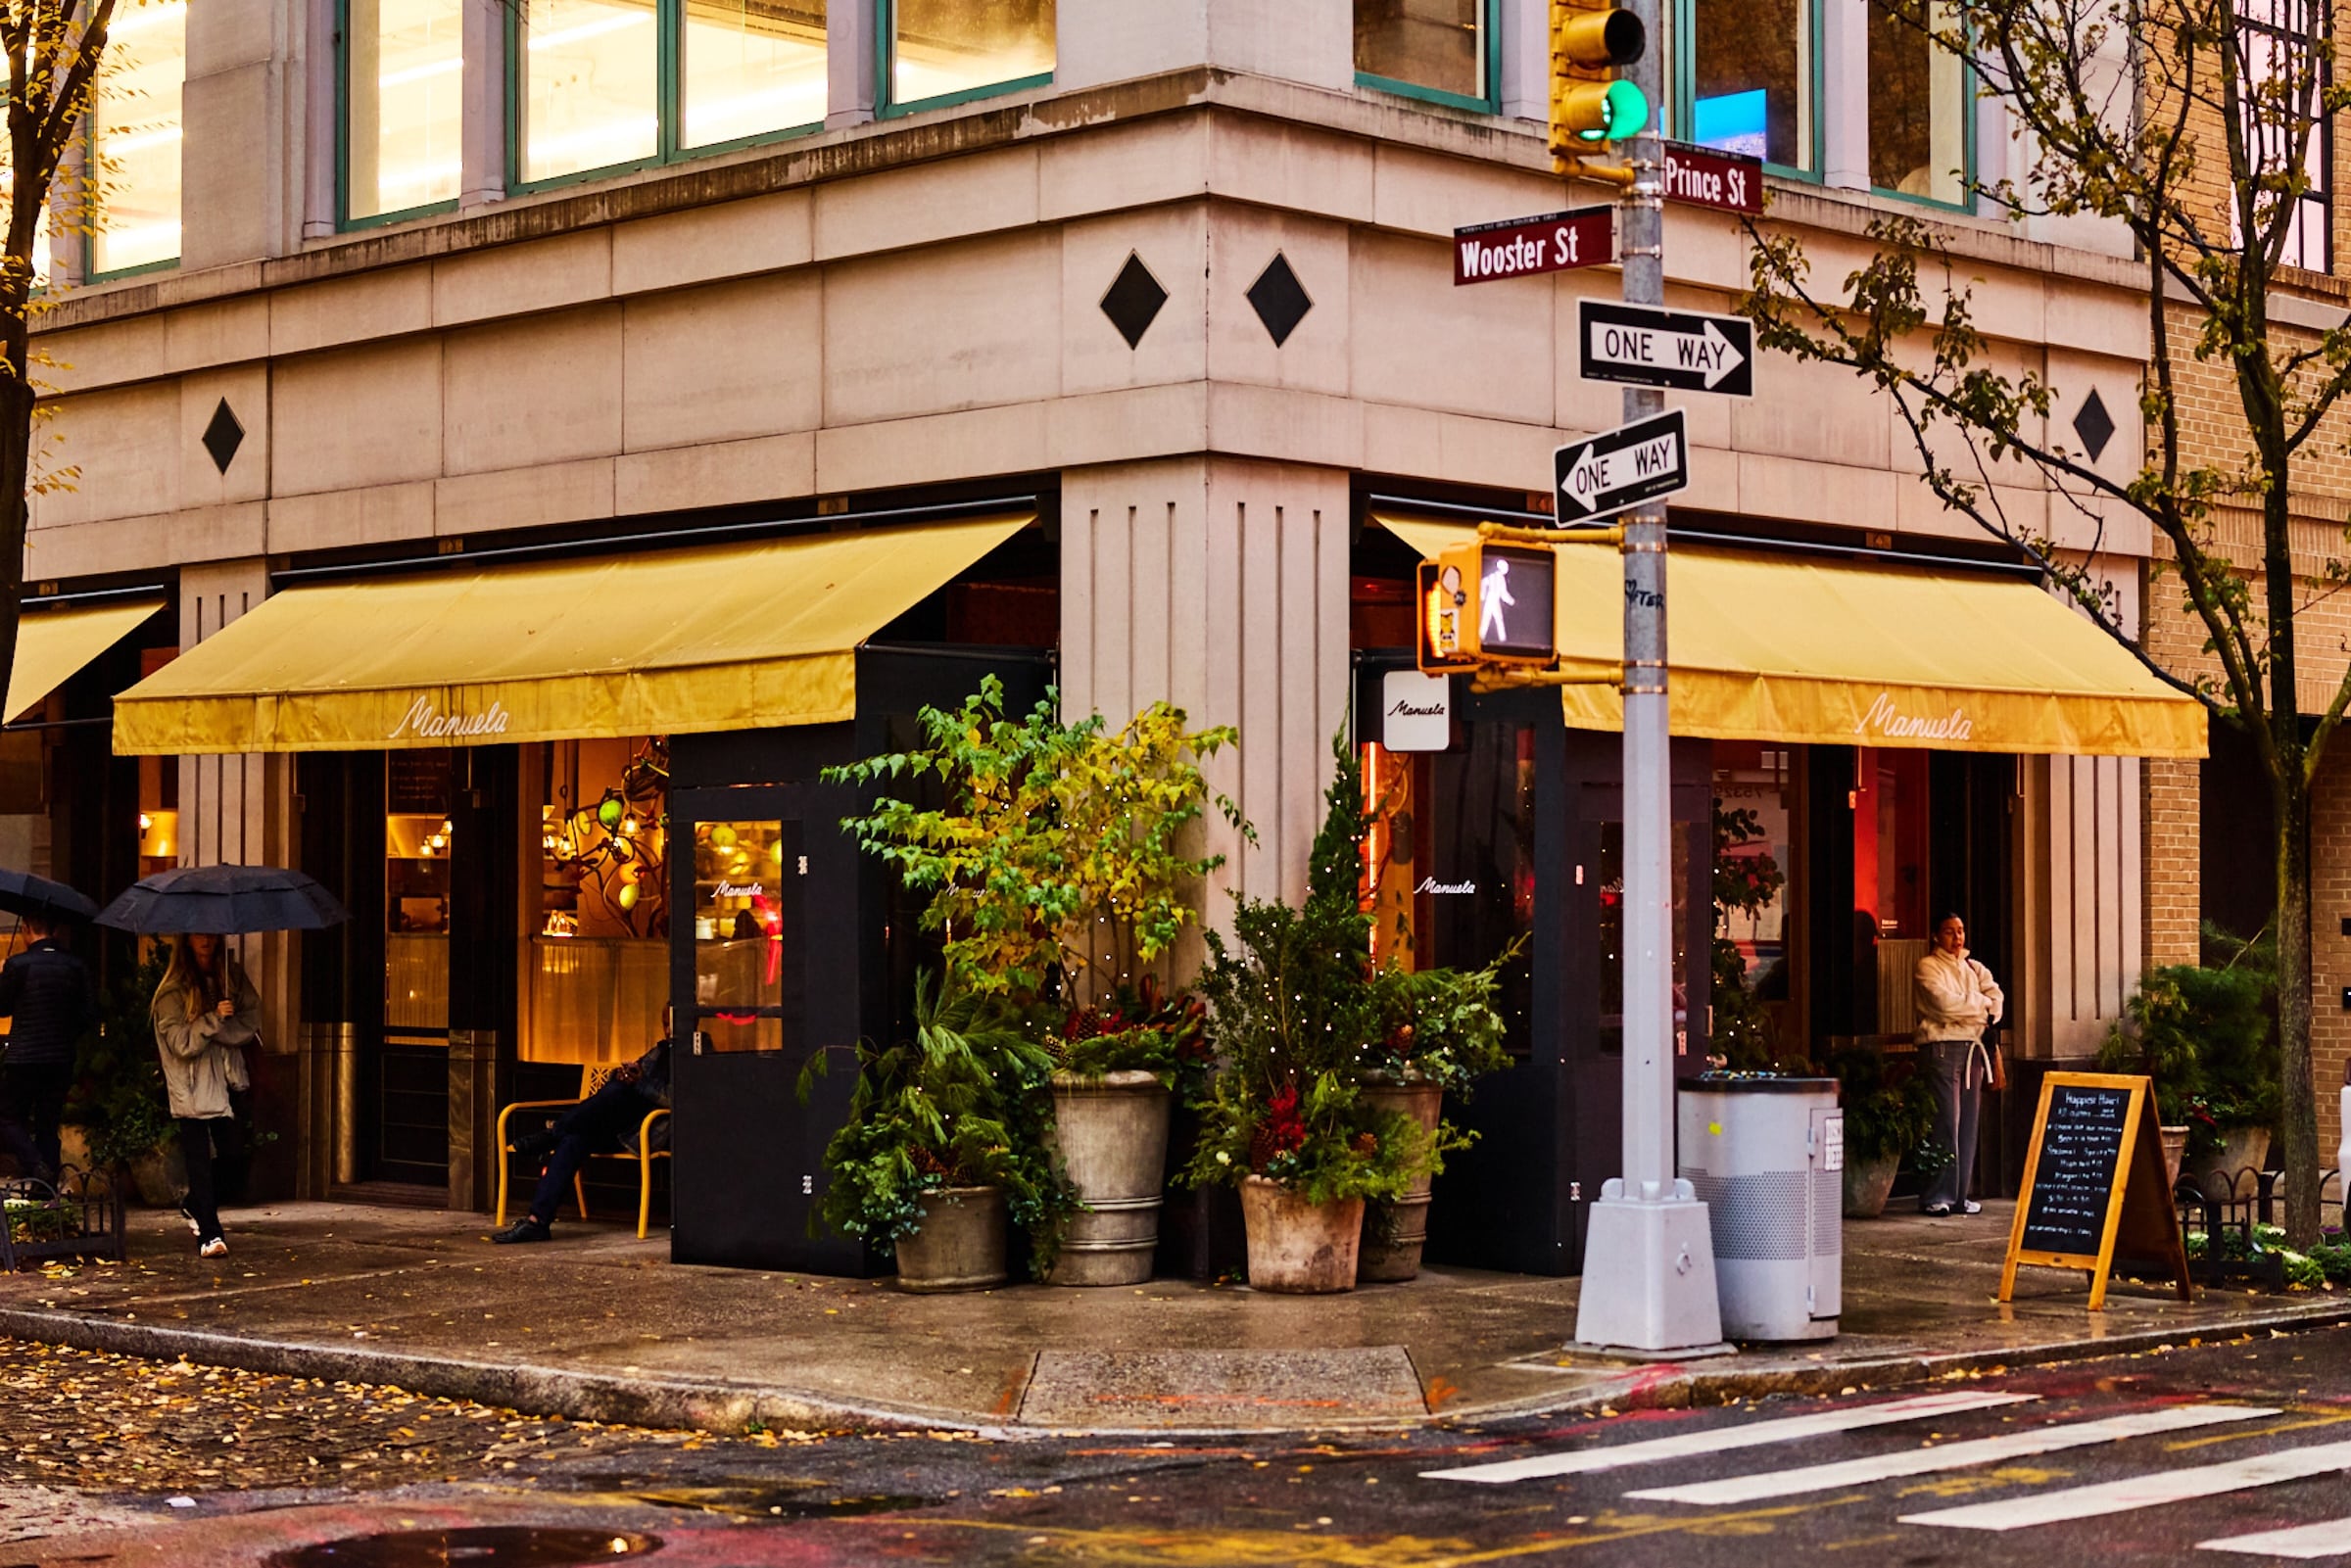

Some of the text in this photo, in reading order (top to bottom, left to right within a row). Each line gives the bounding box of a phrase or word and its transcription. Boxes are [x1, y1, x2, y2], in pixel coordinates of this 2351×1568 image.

[1665, 156, 1747, 207] Prince St
[1461, 225, 1579, 278] Wooster St
[1606, 329, 1726, 370] ONE WAY
[1576, 458, 1611, 495] ONE
[1635, 438, 1670, 477] WAY
[388, 694, 508, 738] Manuela
[1387, 698, 1445, 717] Manuela
[1854, 691, 1973, 740] Manuela
[709, 879, 763, 898] Manuela
[1413, 876, 1476, 895] Manuela
